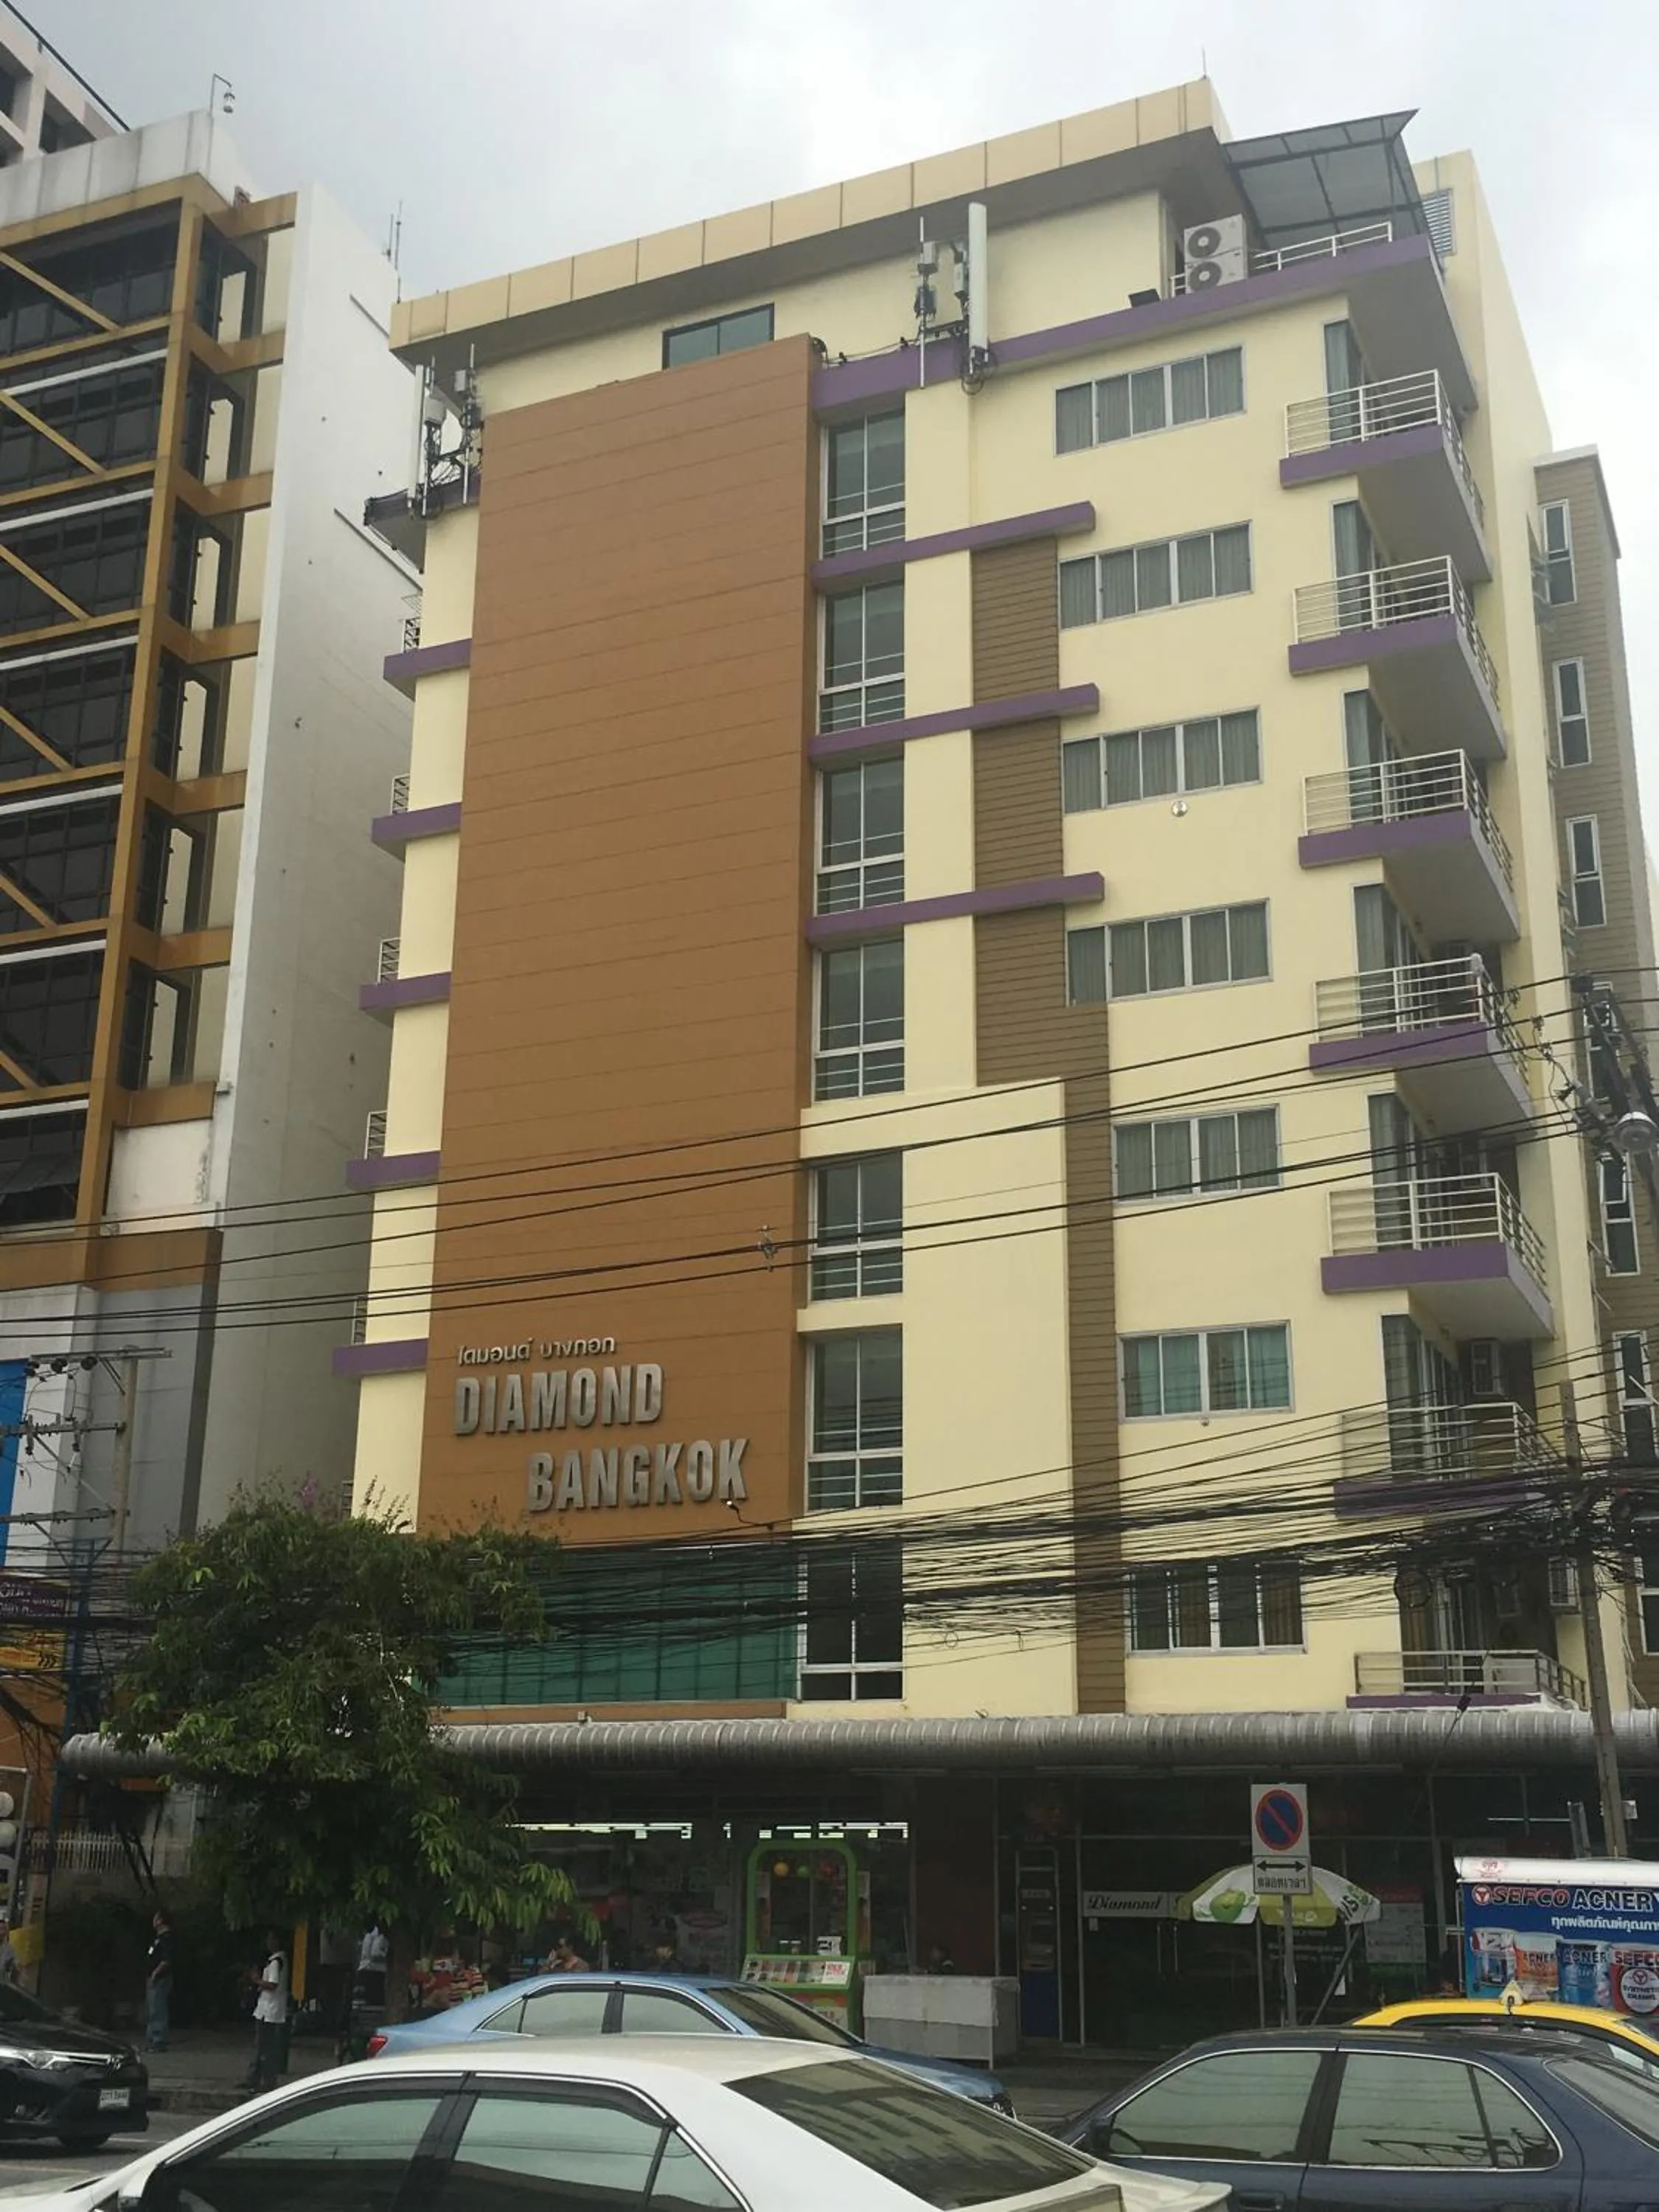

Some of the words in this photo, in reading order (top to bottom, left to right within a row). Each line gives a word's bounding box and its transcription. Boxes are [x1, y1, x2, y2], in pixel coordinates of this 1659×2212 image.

[458, 1337, 534, 1366] ไดมอนด์
[540, 1336, 615, 1359] บางกอก
[454, 1363, 663, 1436] DIAMOND
[527, 1439, 748, 1512] BANGKOK
[1088, 1894, 1162, 1911] Diamond
[1492, 1885, 1571, 1908] SEFCO
[1572, 1888, 1653, 1913] ACNER
[1551, 1915, 1659, 1933] ทุกผลิตภัณฑ์คุณภา
